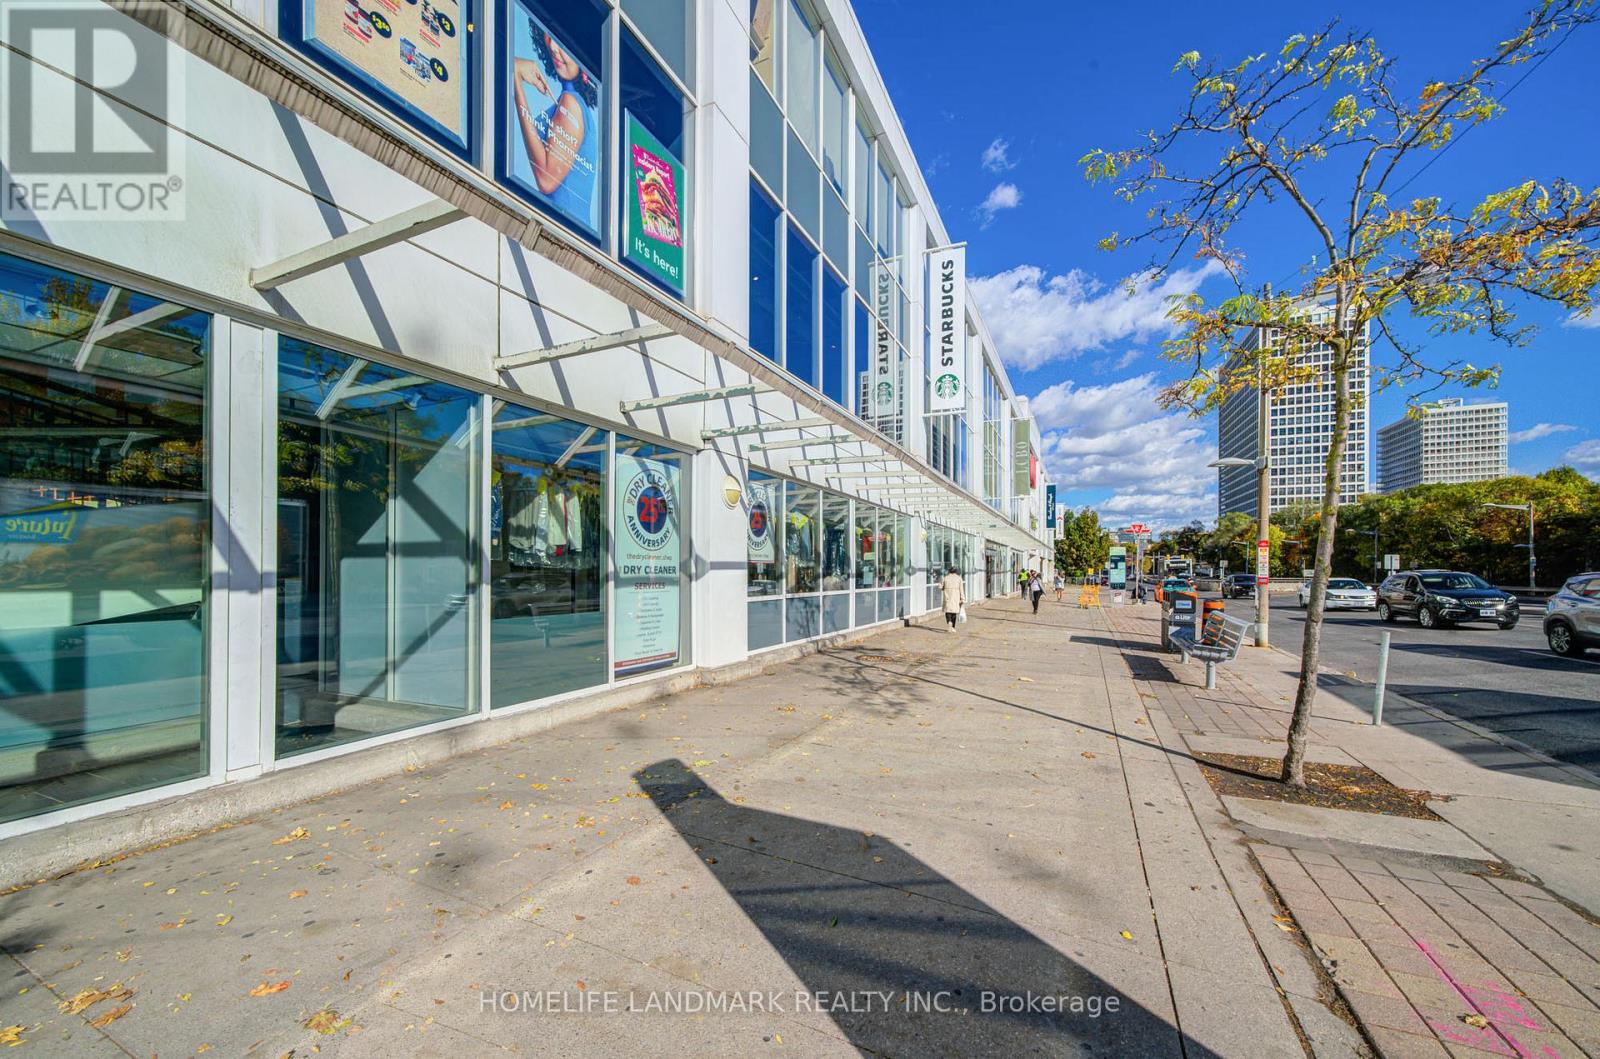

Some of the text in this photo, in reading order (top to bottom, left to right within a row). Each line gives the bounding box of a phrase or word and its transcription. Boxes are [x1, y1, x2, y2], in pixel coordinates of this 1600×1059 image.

[520, 104, 546, 134] Think
[548, 130, 595, 173] Pharmacist.
[541, 110, 554, 128] Flu
[556, 125, 578, 147] shot?
[635, 237, 678, 279] It's here!
[941, 259, 954, 367] STARBUCKS
[1015, 441, 1028, 474] LCBO
[629, 475, 645, 500] DRY
[626, 515, 671, 548] ANNIVERSARY
[623, 565, 677, 575] DRY CLEANER
[634, 582, 666, 590] SERVICES
